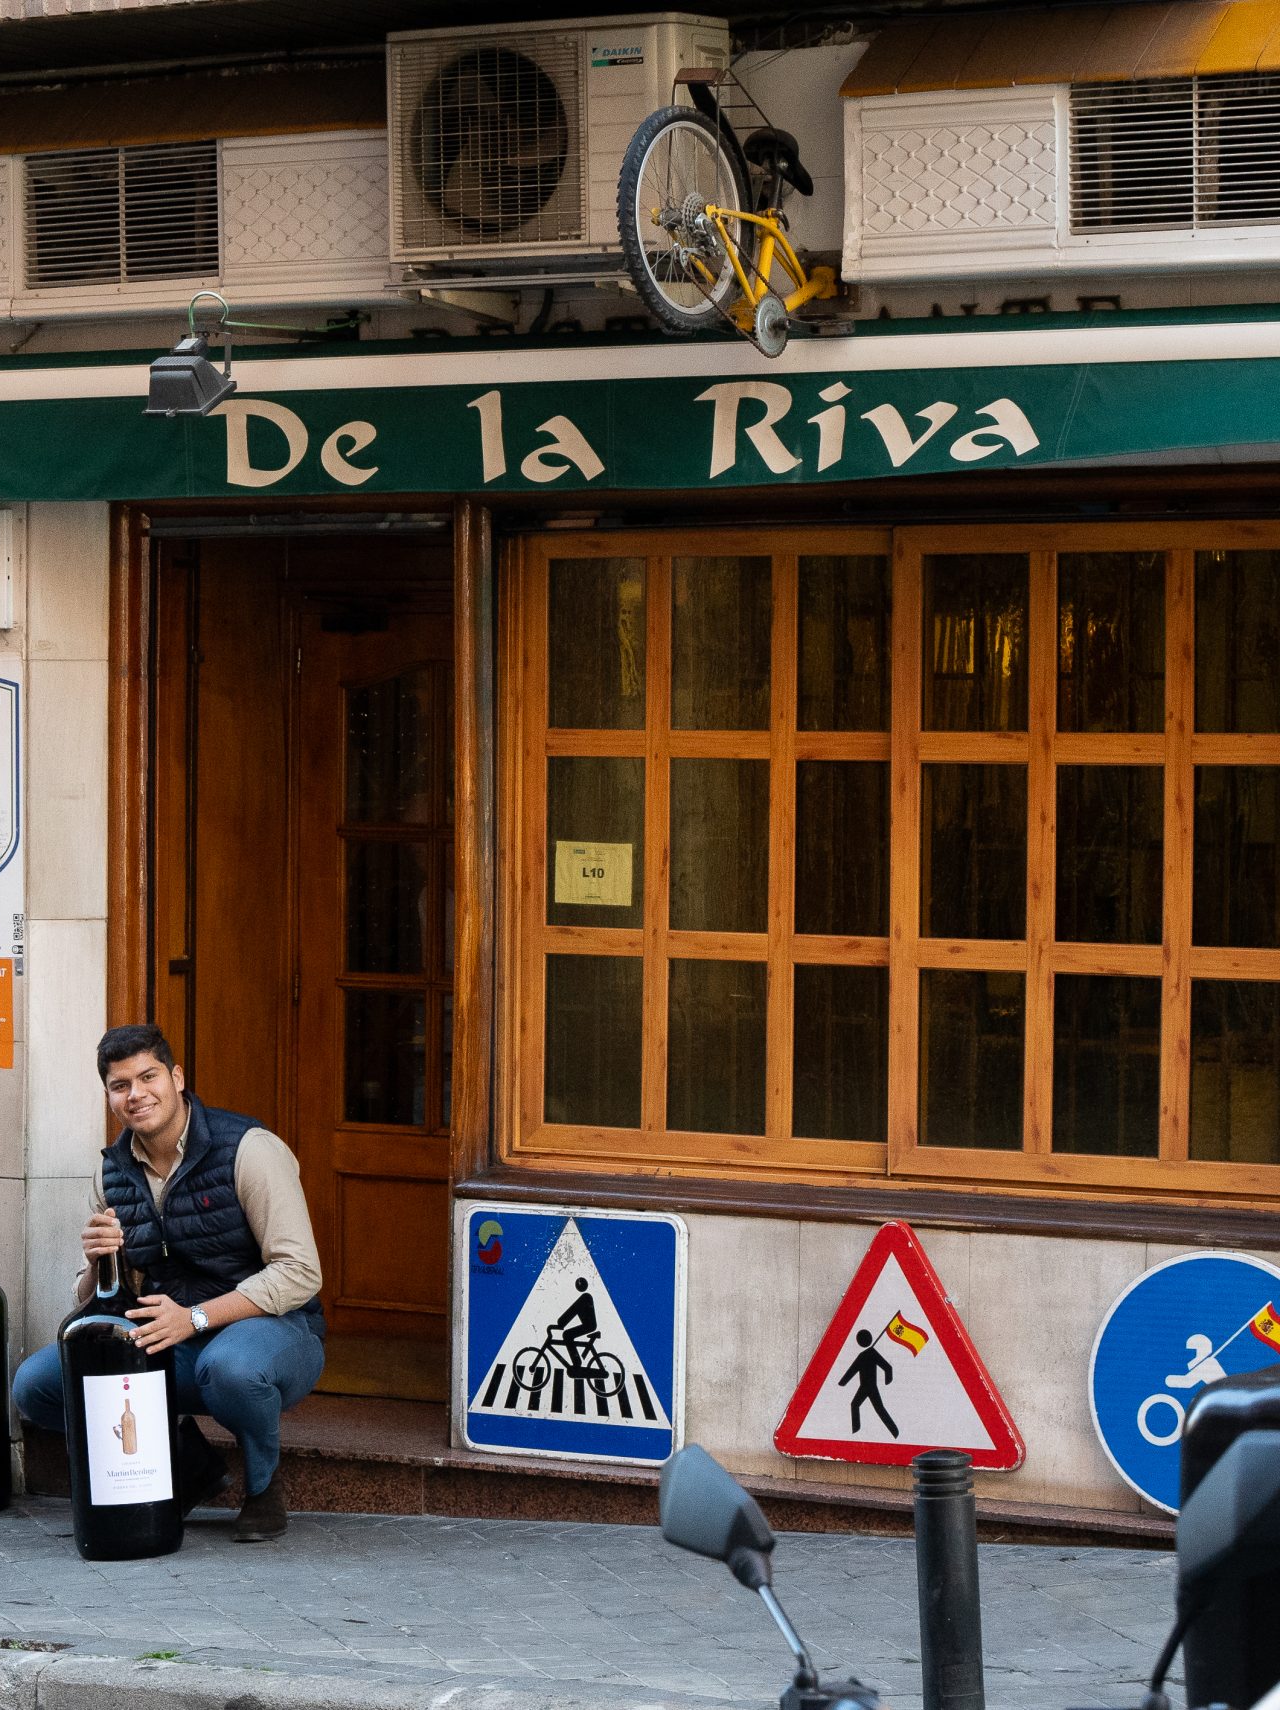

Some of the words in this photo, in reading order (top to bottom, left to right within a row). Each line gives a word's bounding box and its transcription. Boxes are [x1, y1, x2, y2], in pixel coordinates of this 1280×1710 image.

[603, 47, 642, 56] DAIKIN
[206, 398, 379, 488] De
[467, 390, 605, 483] la
[695, 380, 1041, 479] Riva
[582, 867, 605, 878] L10
